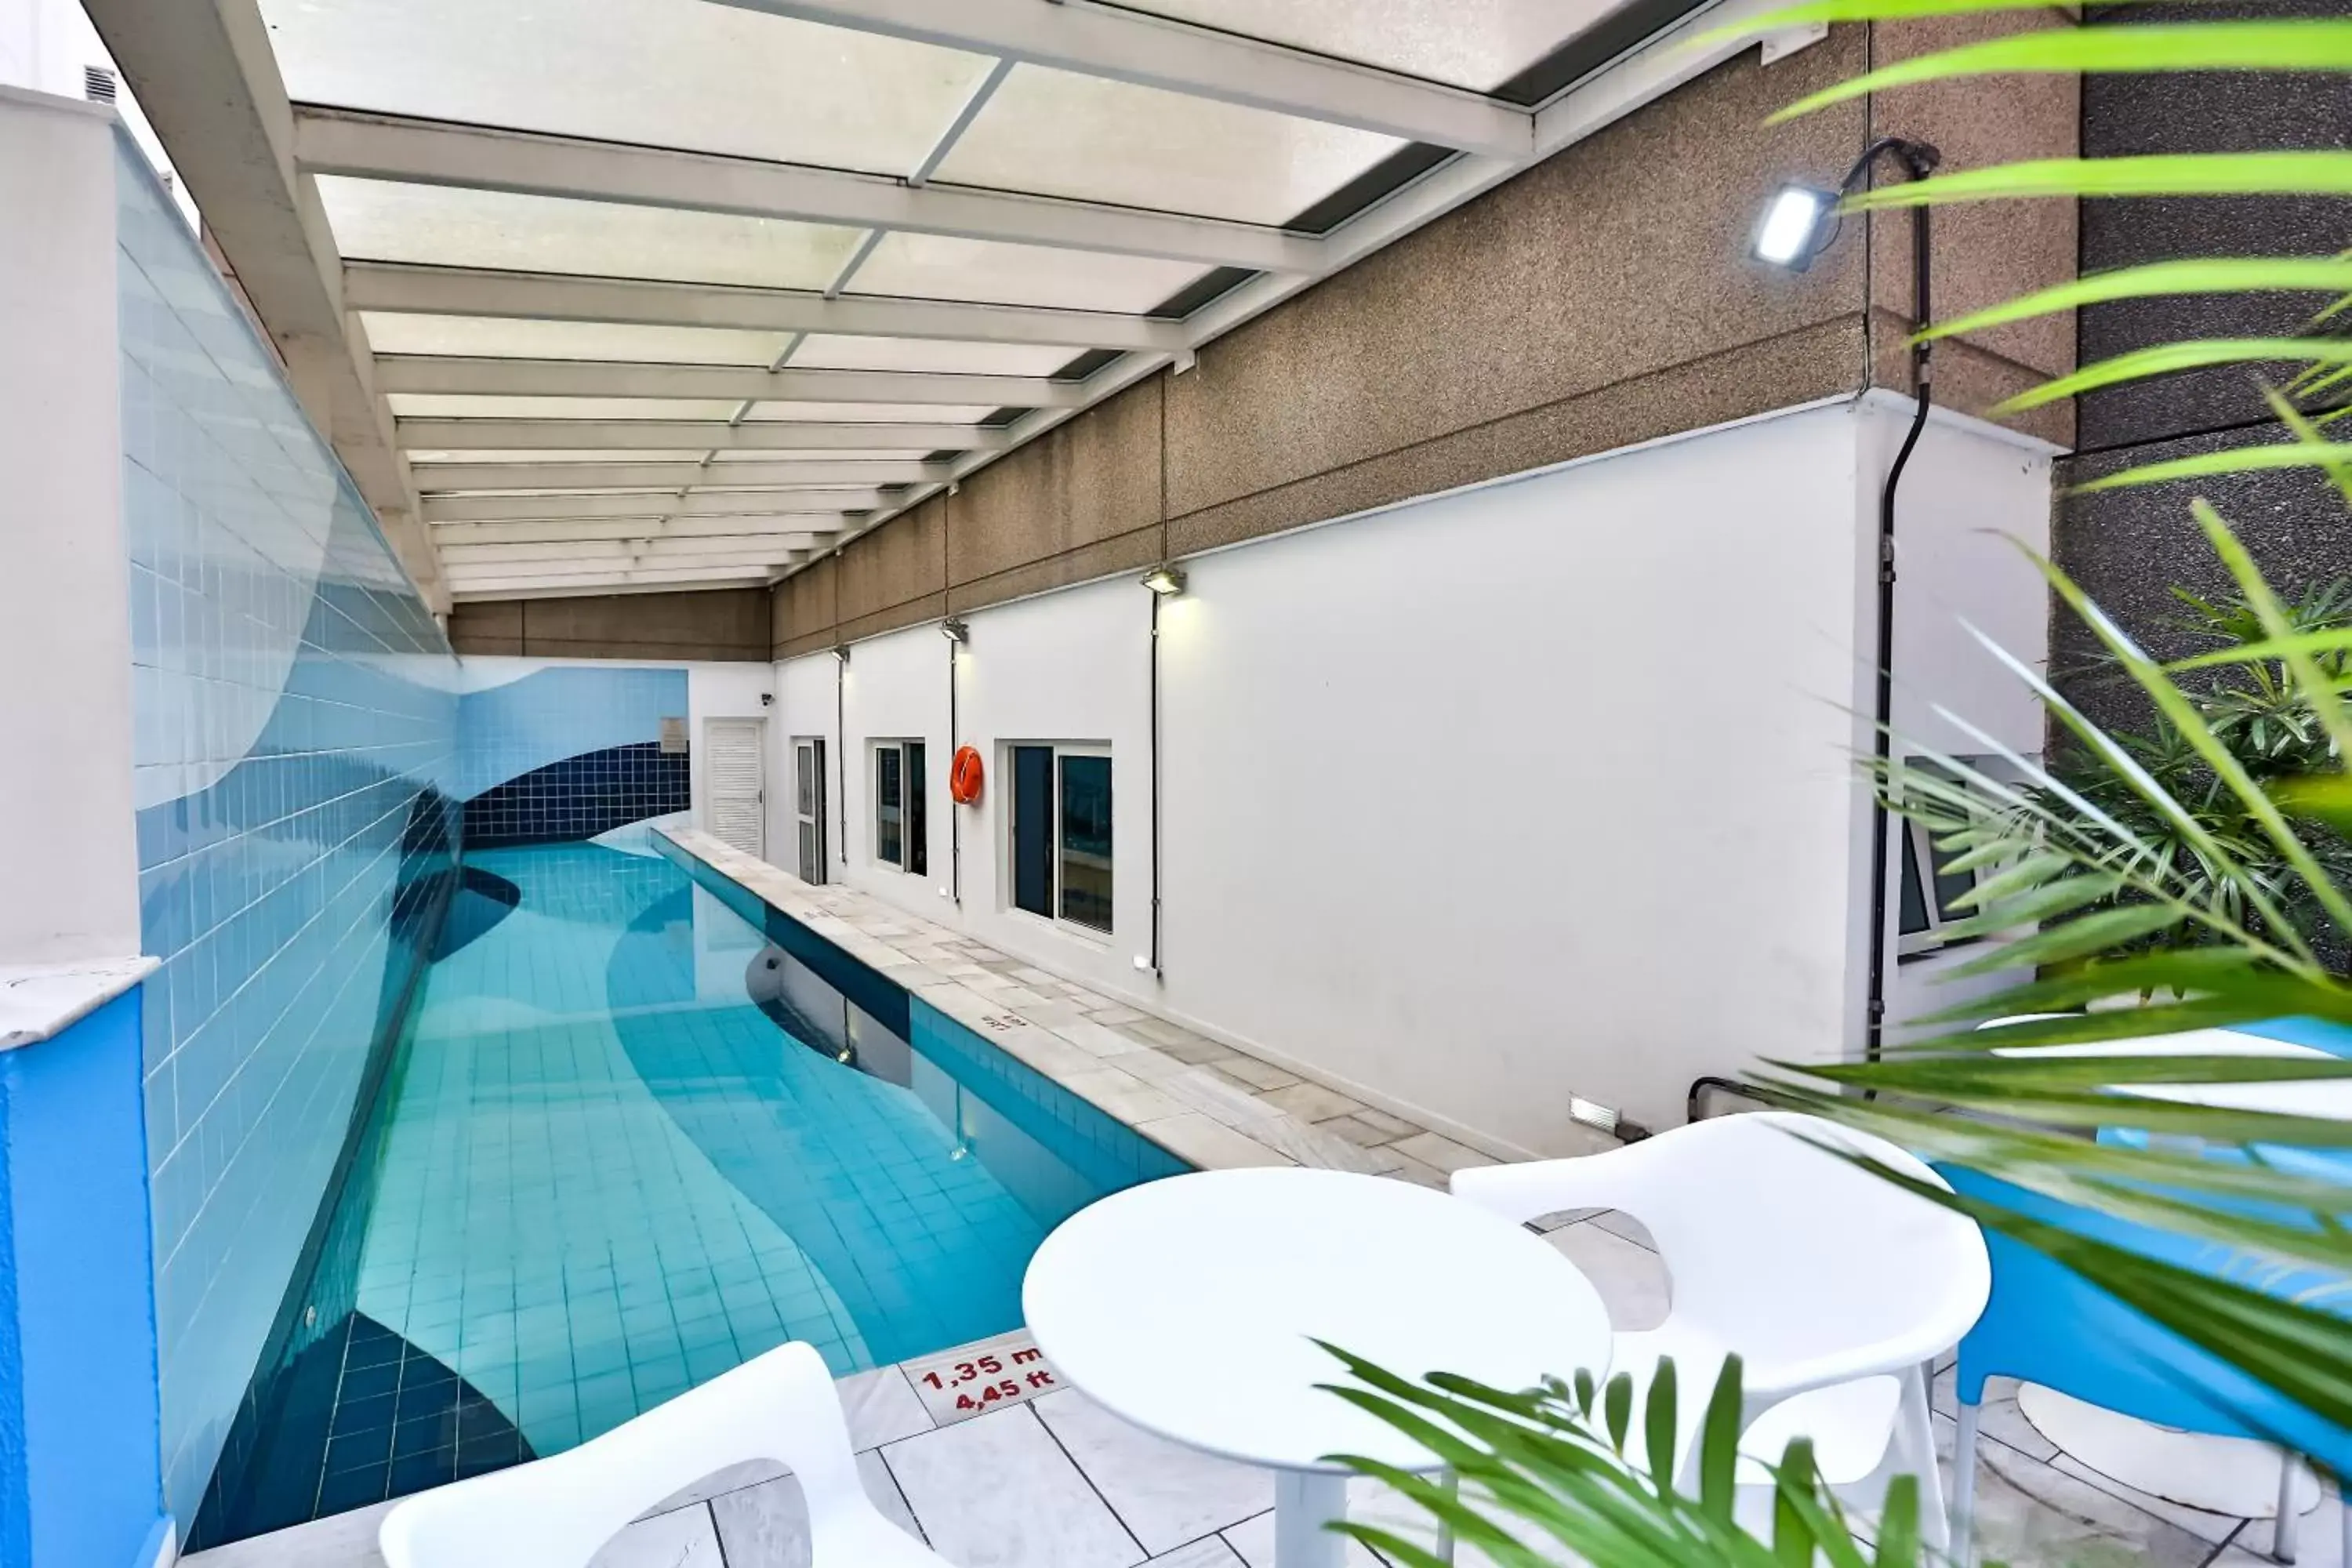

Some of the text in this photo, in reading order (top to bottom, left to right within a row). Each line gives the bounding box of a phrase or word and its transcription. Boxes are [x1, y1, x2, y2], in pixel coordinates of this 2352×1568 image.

[922, 1348, 1044, 1390] 1,35 m
[956, 1370, 1054, 1411] 4,45 ft
